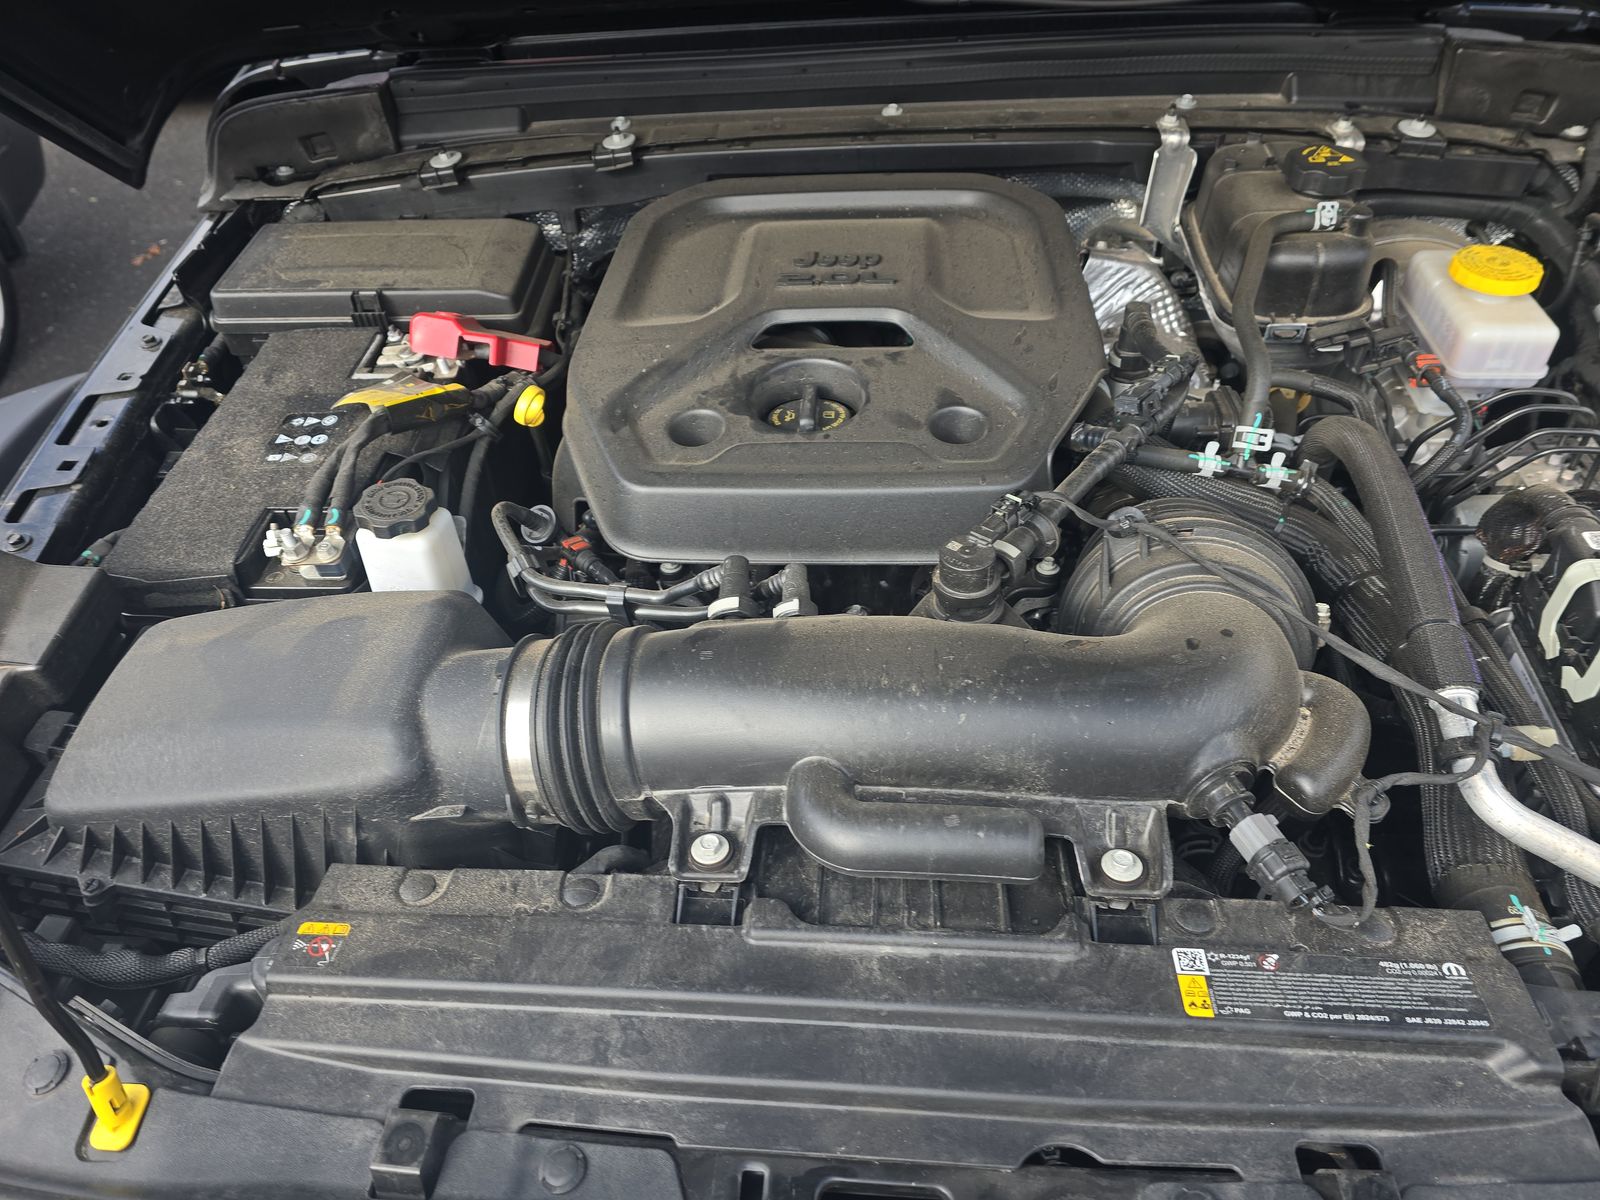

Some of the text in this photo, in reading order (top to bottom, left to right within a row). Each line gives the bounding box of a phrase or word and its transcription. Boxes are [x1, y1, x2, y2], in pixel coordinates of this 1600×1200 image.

[793, 251, 882, 269] Jeep
[776, 272, 898, 286] 2.0L
[1284, 1010, 1303, 1018] GWP
